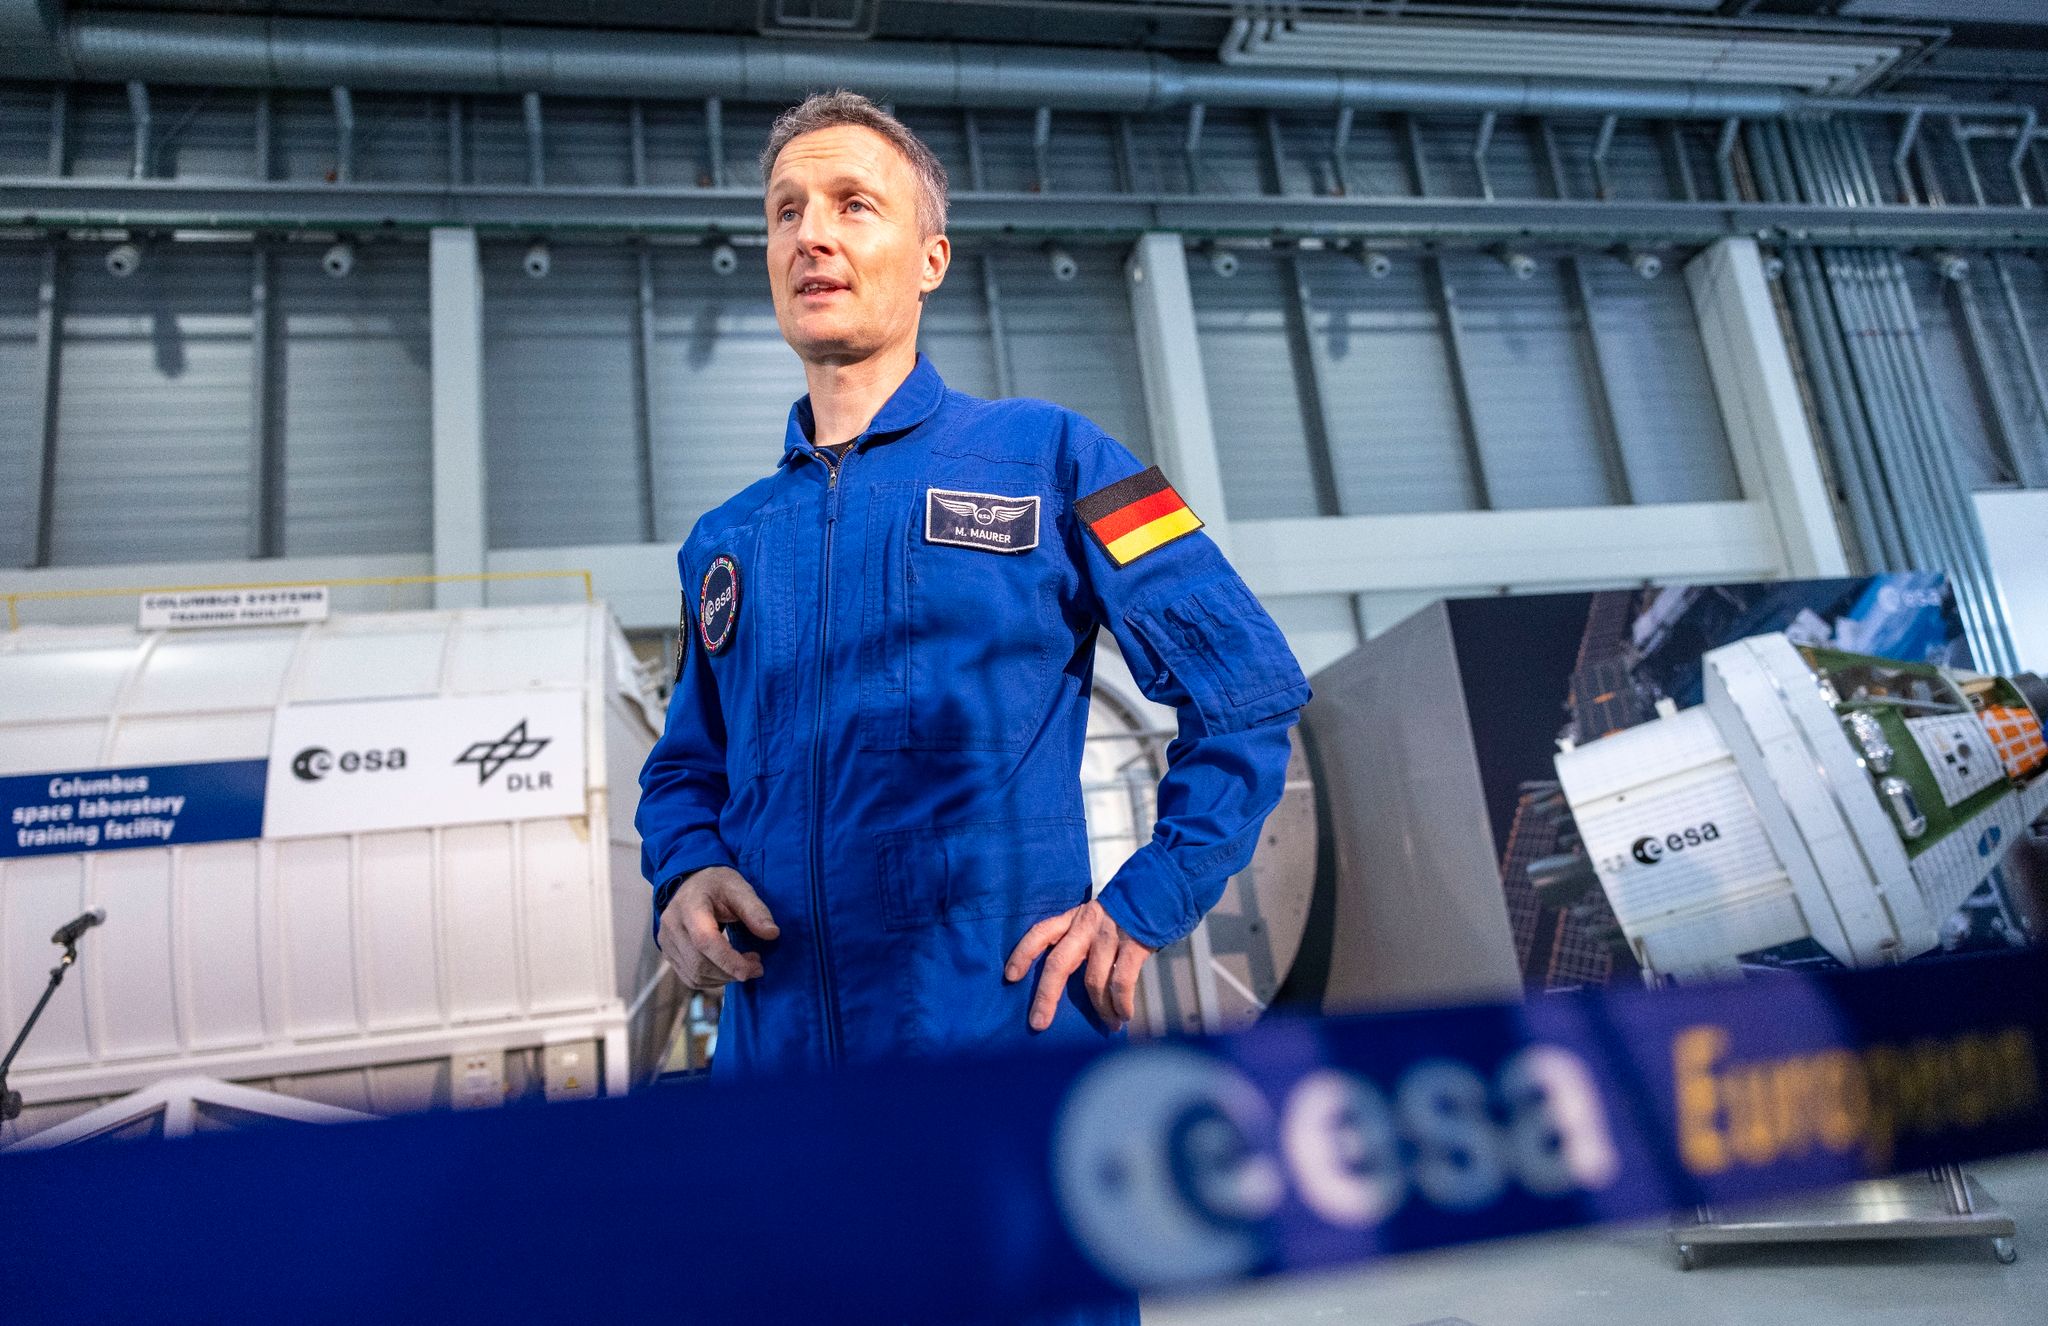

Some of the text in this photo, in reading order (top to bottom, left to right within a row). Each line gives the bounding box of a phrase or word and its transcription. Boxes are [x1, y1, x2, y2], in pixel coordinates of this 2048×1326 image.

[955, 526, 1011, 544] M. MAURER
[714, 586, 732, 612] esa
[339, 747, 407, 773] esa
[49, 774, 149, 798] Columbus
[506, 771, 553, 792] DLR
[12, 795, 186, 826] space laboratory
[17, 817, 175, 847] training facility
[1666, 821, 1720, 852] esa
[1282, 1044, 1618, 1228] esa
